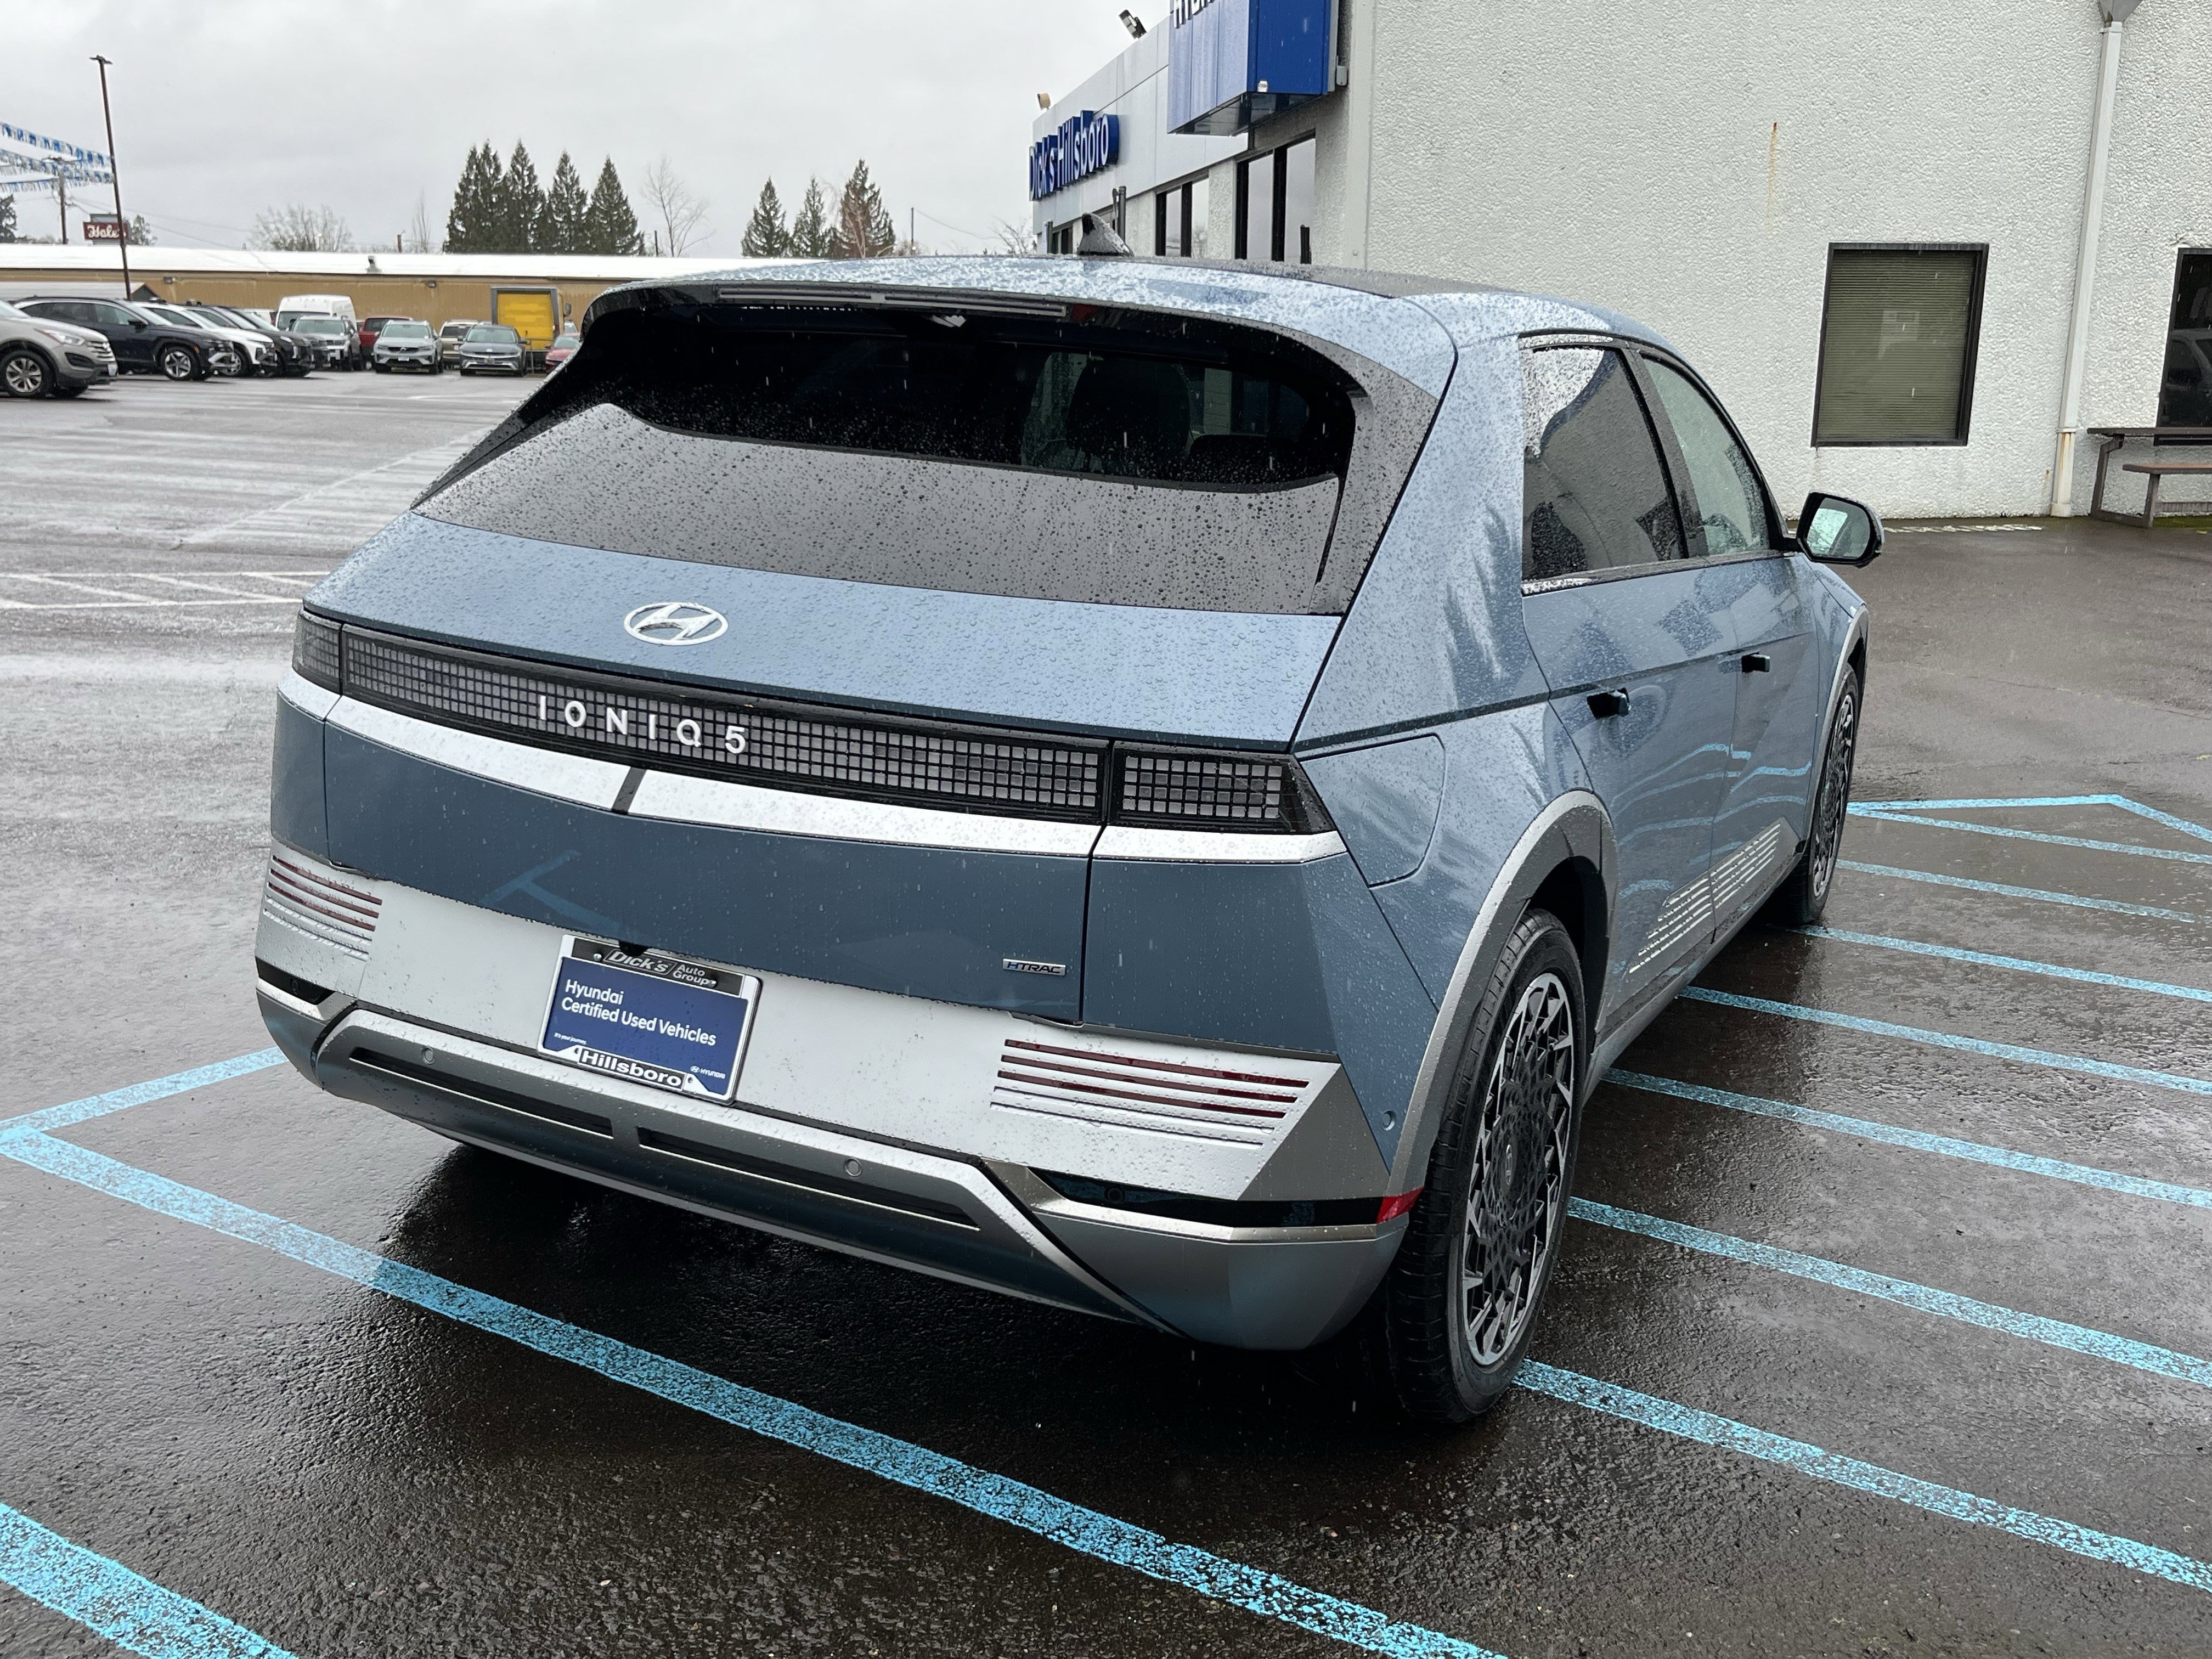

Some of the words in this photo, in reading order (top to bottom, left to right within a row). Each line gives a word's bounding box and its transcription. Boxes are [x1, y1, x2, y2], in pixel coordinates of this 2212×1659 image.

[1029, 134, 1056, 202] Dick's
[1057, 110, 1111, 188] Hillsboro
[539, 695, 702, 748] IONIQ
[725, 725, 747, 755] 5
[608, 951, 669, 973] Dick's
[676, 964, 706, 977] Auto
[1007, 961, 1061, 974] HTRAC
[673, 970, 709, 986] Group
[565, 979, 624, 1005] Hyundai
[561, 996, 620, 1023] Certified
[621, 1011, 657, 1032] Used
[659, 1019, 717, 1046] Vehicles
[582, 1050, 682, 1086] Hillsboro
[700, 1068, 726, 1080] HYUNDAI
